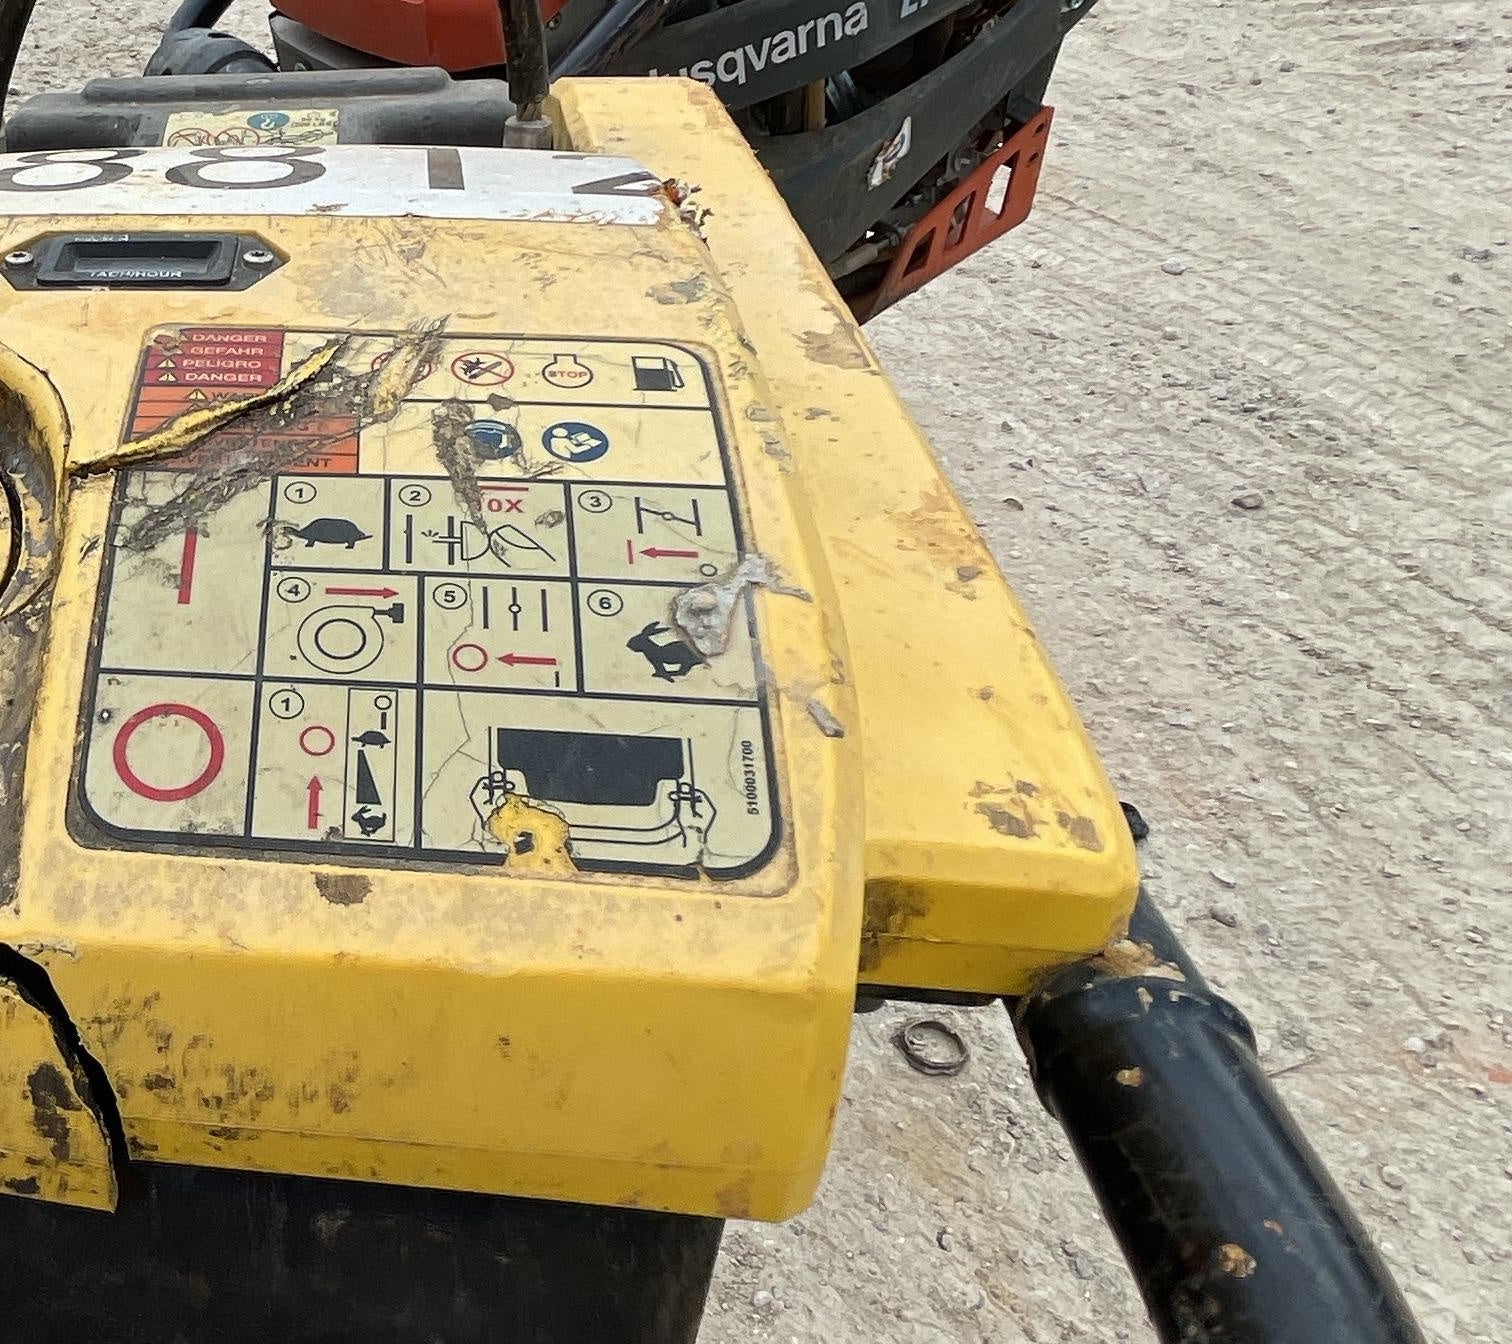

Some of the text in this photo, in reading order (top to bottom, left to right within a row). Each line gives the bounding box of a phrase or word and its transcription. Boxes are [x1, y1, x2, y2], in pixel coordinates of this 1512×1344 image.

[649, 2, 869, 86] sqvarna
[192, 334, 267, 343] DANGER
[190, 346, 264, 356] GEFAHR
[182, 358, 262, 369] PELIGRO
[185, 372, 263, 383] DANGER
[548, 370, 588, 378] STOP
[590, 496, 602, 508] 3
[287, 584, 301, 597] 4
[443, 590, 456, 603] 5
[599, 597, 612, 610] 6
